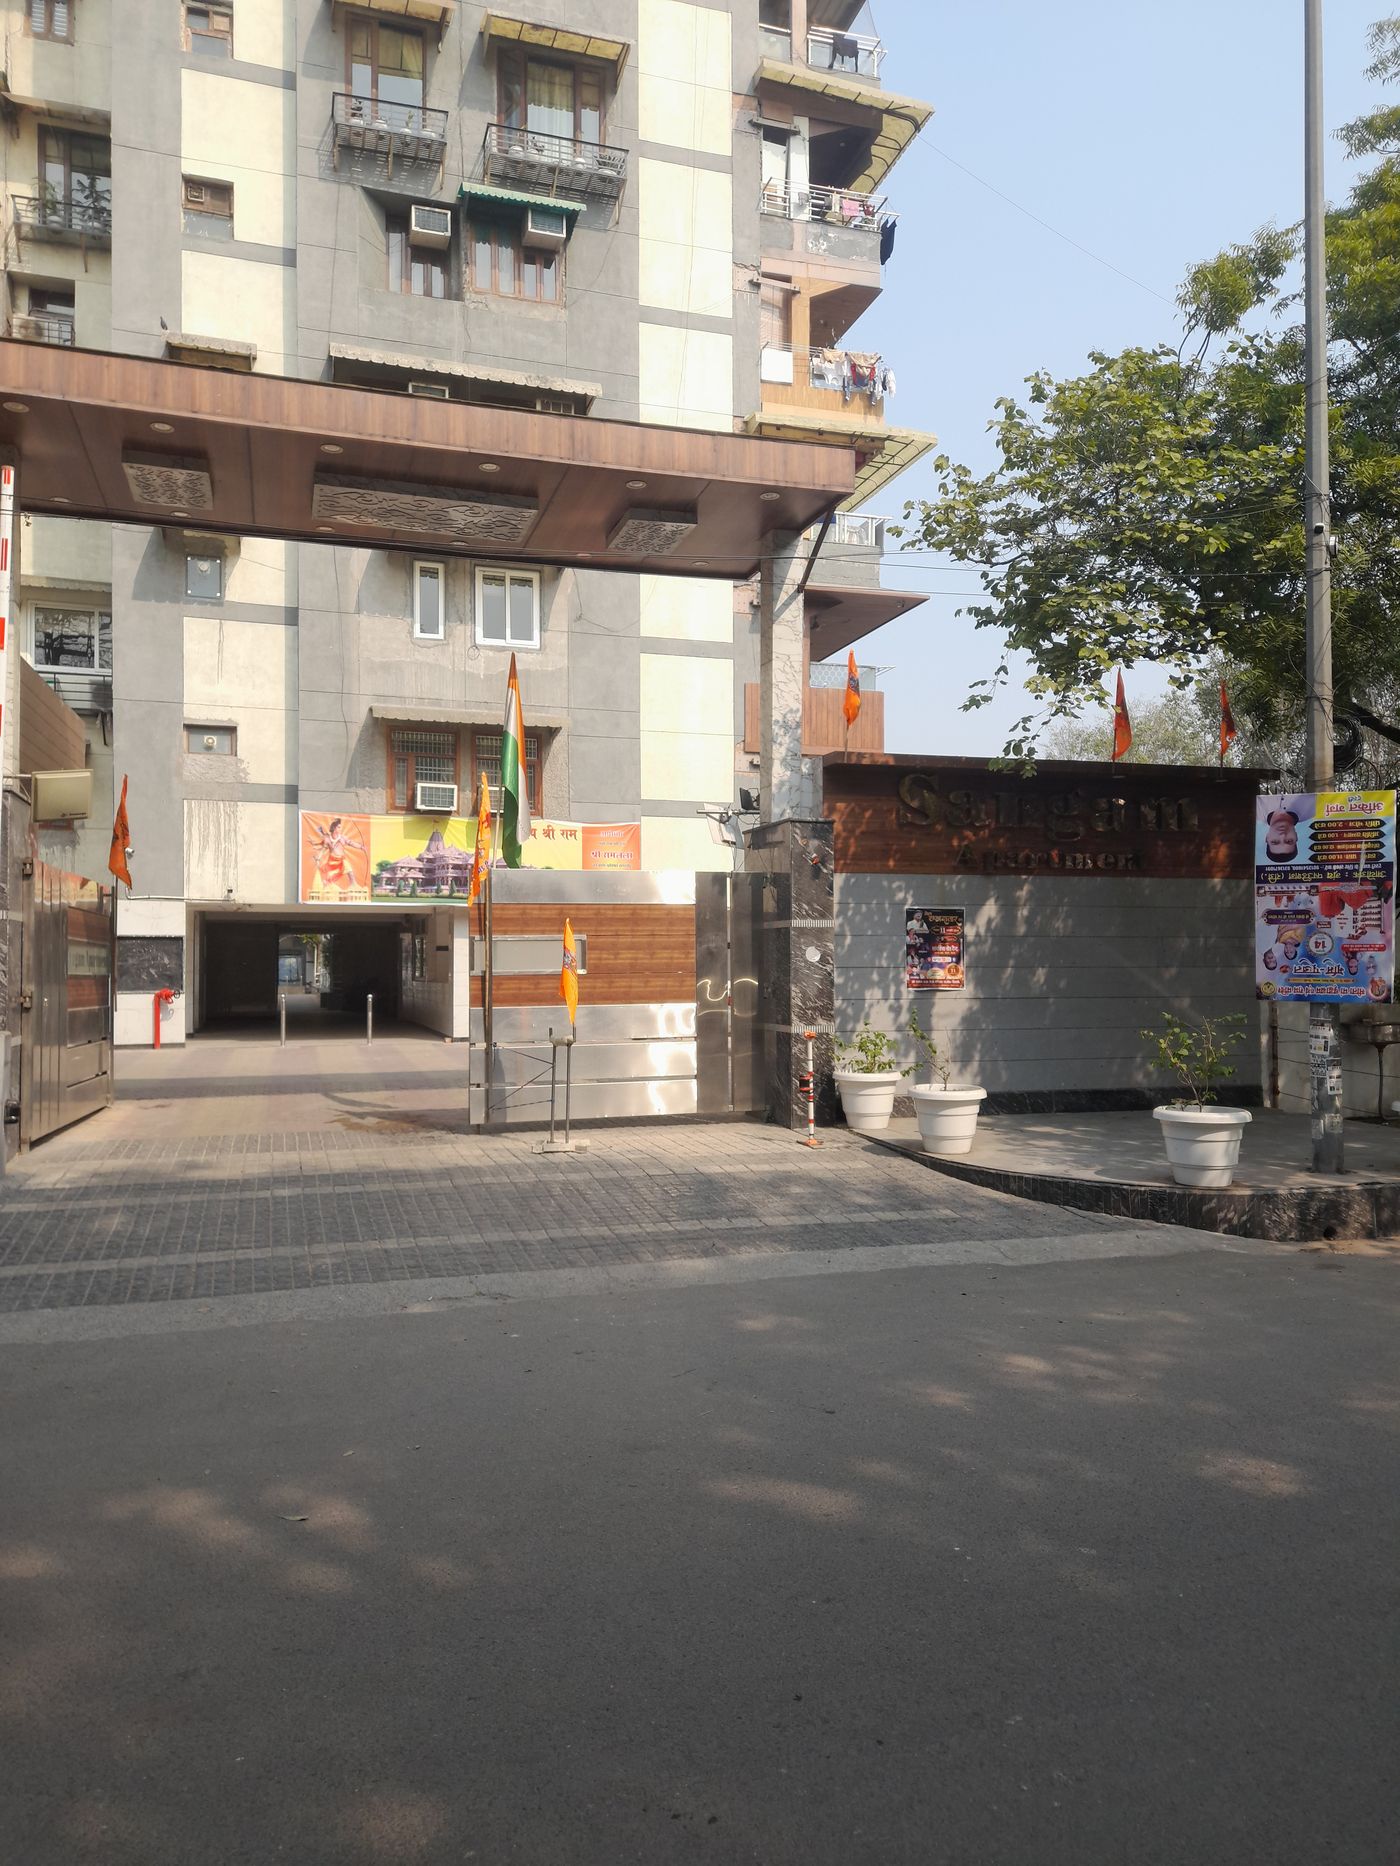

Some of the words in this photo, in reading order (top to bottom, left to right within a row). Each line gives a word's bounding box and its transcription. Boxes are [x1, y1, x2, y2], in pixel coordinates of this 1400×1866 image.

[898, 773, 1199, 842] Sangam
[1326, 804, 1345, 816] गर्ग
[1349, 802, 1383, 814] अंकित
[542, 824, 556, 840] श्री
[560, 828, 578, 840] राम
[1315, 941, 1326, 949] 14
